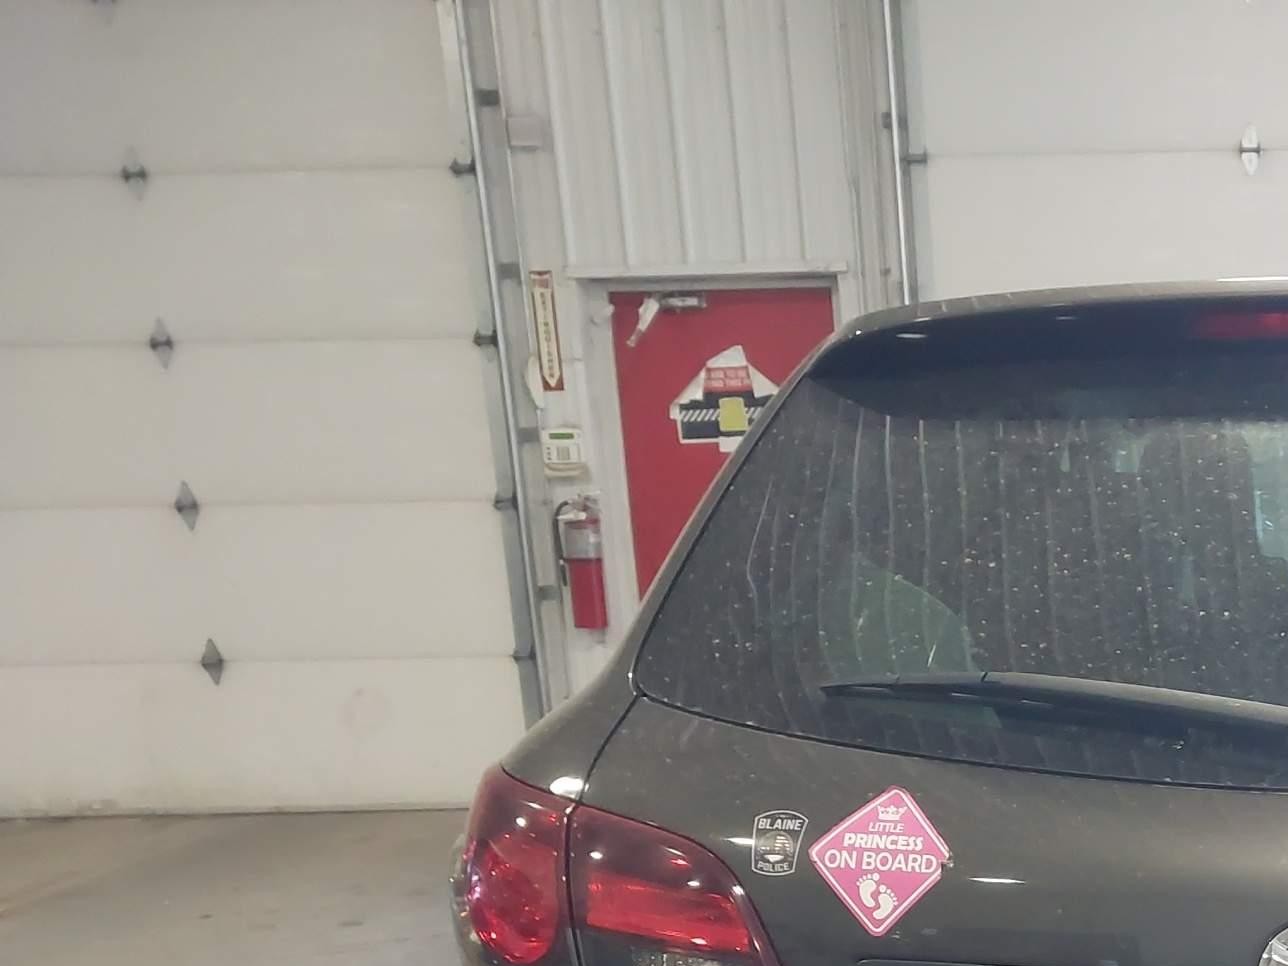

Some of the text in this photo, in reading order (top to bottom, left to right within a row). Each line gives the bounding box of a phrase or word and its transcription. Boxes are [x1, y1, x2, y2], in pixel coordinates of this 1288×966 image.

[758, 818, 803, 831] BLAINE
[868, 822, 905, 833] LITTLE
[843, 832, 924, 851] PRINCESS
[757, 861, 790, 872] POLICE
[824, 849, 937, 873] ON BOARD
